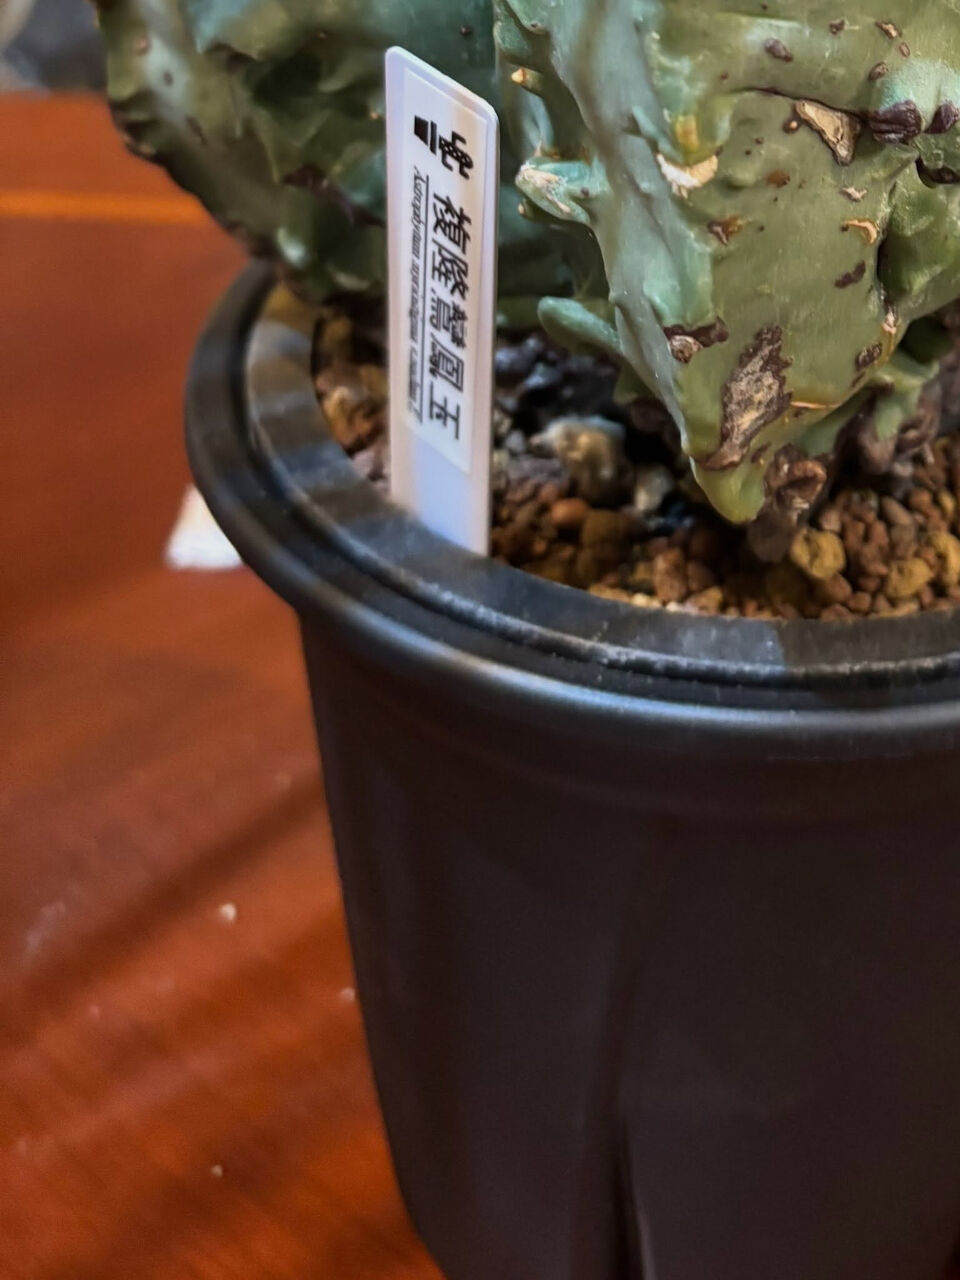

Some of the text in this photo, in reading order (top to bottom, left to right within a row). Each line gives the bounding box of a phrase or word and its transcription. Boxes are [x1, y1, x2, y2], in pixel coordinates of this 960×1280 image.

[430, 192, 472, 440] 複隆鸞鳳玉
